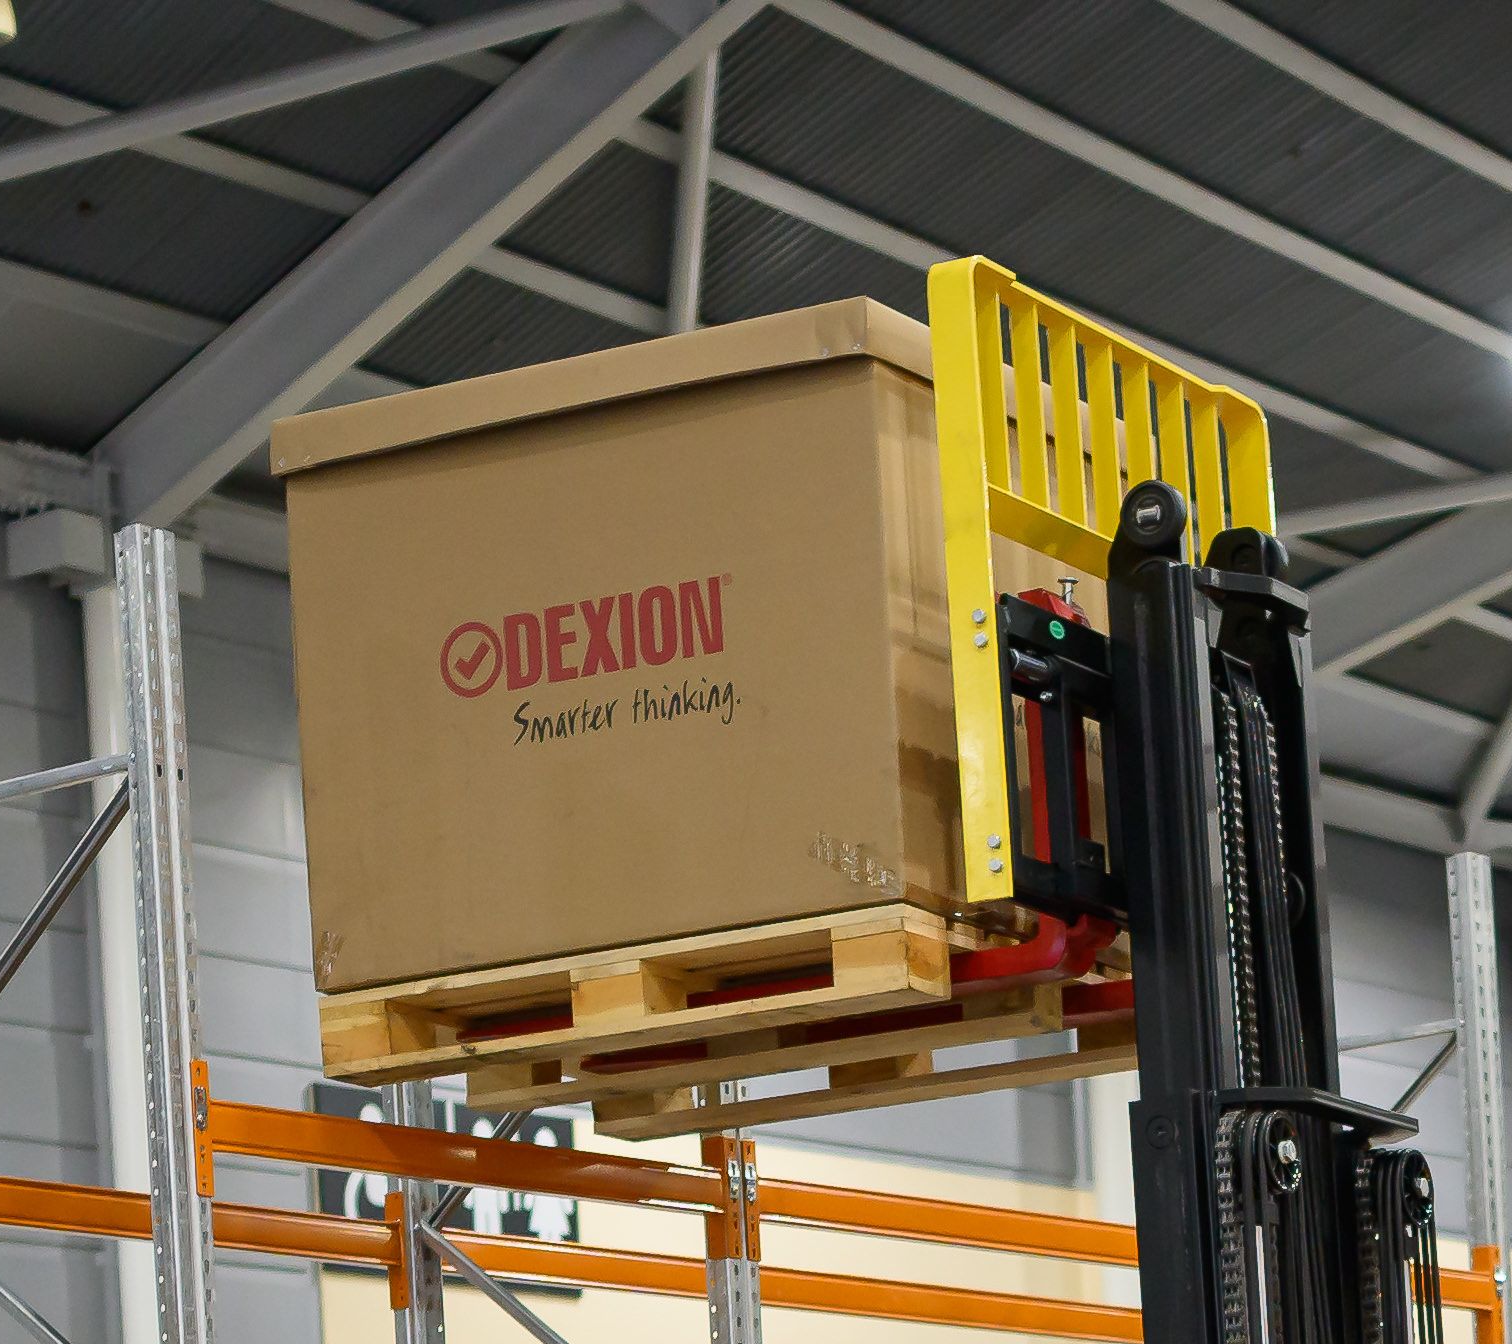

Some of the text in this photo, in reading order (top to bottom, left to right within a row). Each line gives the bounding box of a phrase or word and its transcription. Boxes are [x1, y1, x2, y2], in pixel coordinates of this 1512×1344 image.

[503, 575, 725, 691] DEXION
[513, 677, 741, 746] Smarter thinking.
